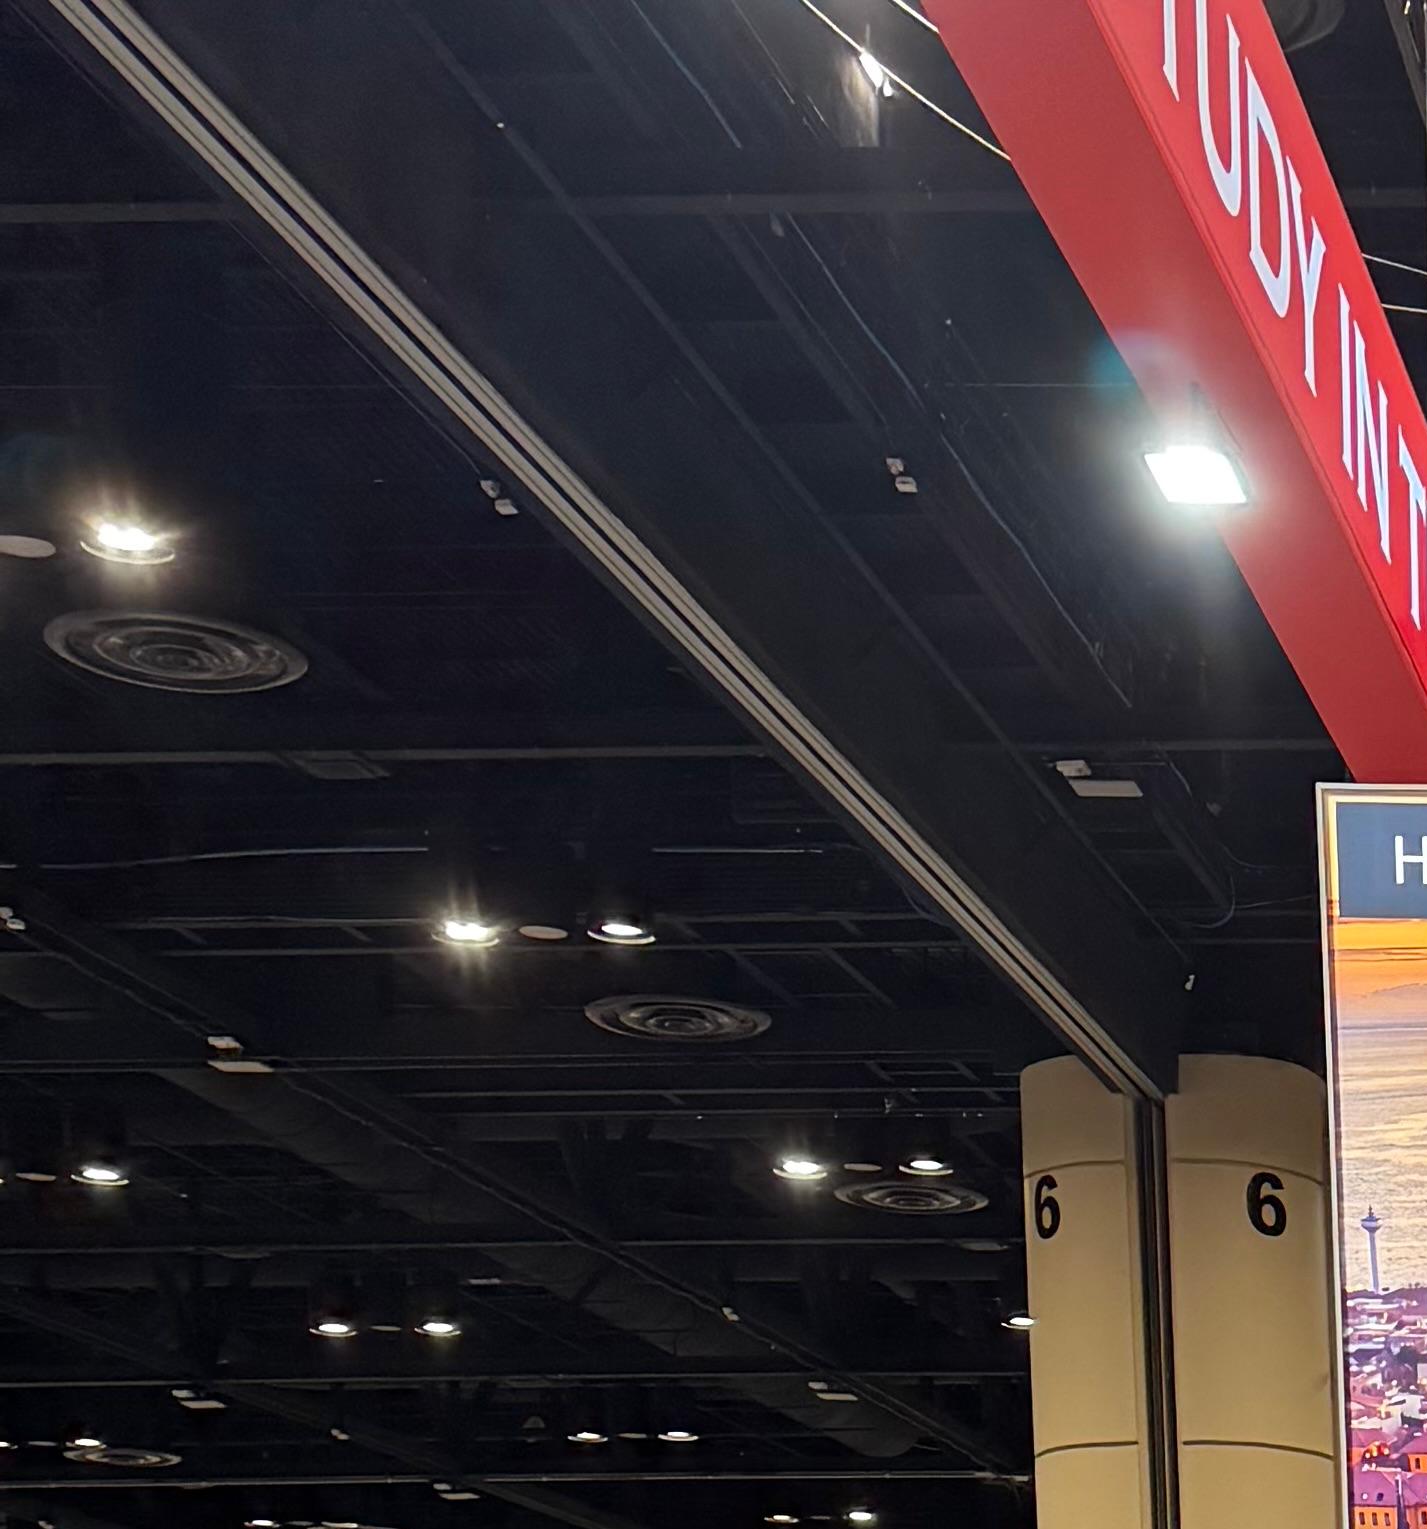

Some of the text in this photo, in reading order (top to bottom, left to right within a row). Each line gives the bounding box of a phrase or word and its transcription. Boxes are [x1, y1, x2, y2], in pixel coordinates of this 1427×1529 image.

[1338, 282, 1392, 564] IN
[1034, 1174, 1061, 1240] 6
[1246, 1171, 1287, 1237] 6
